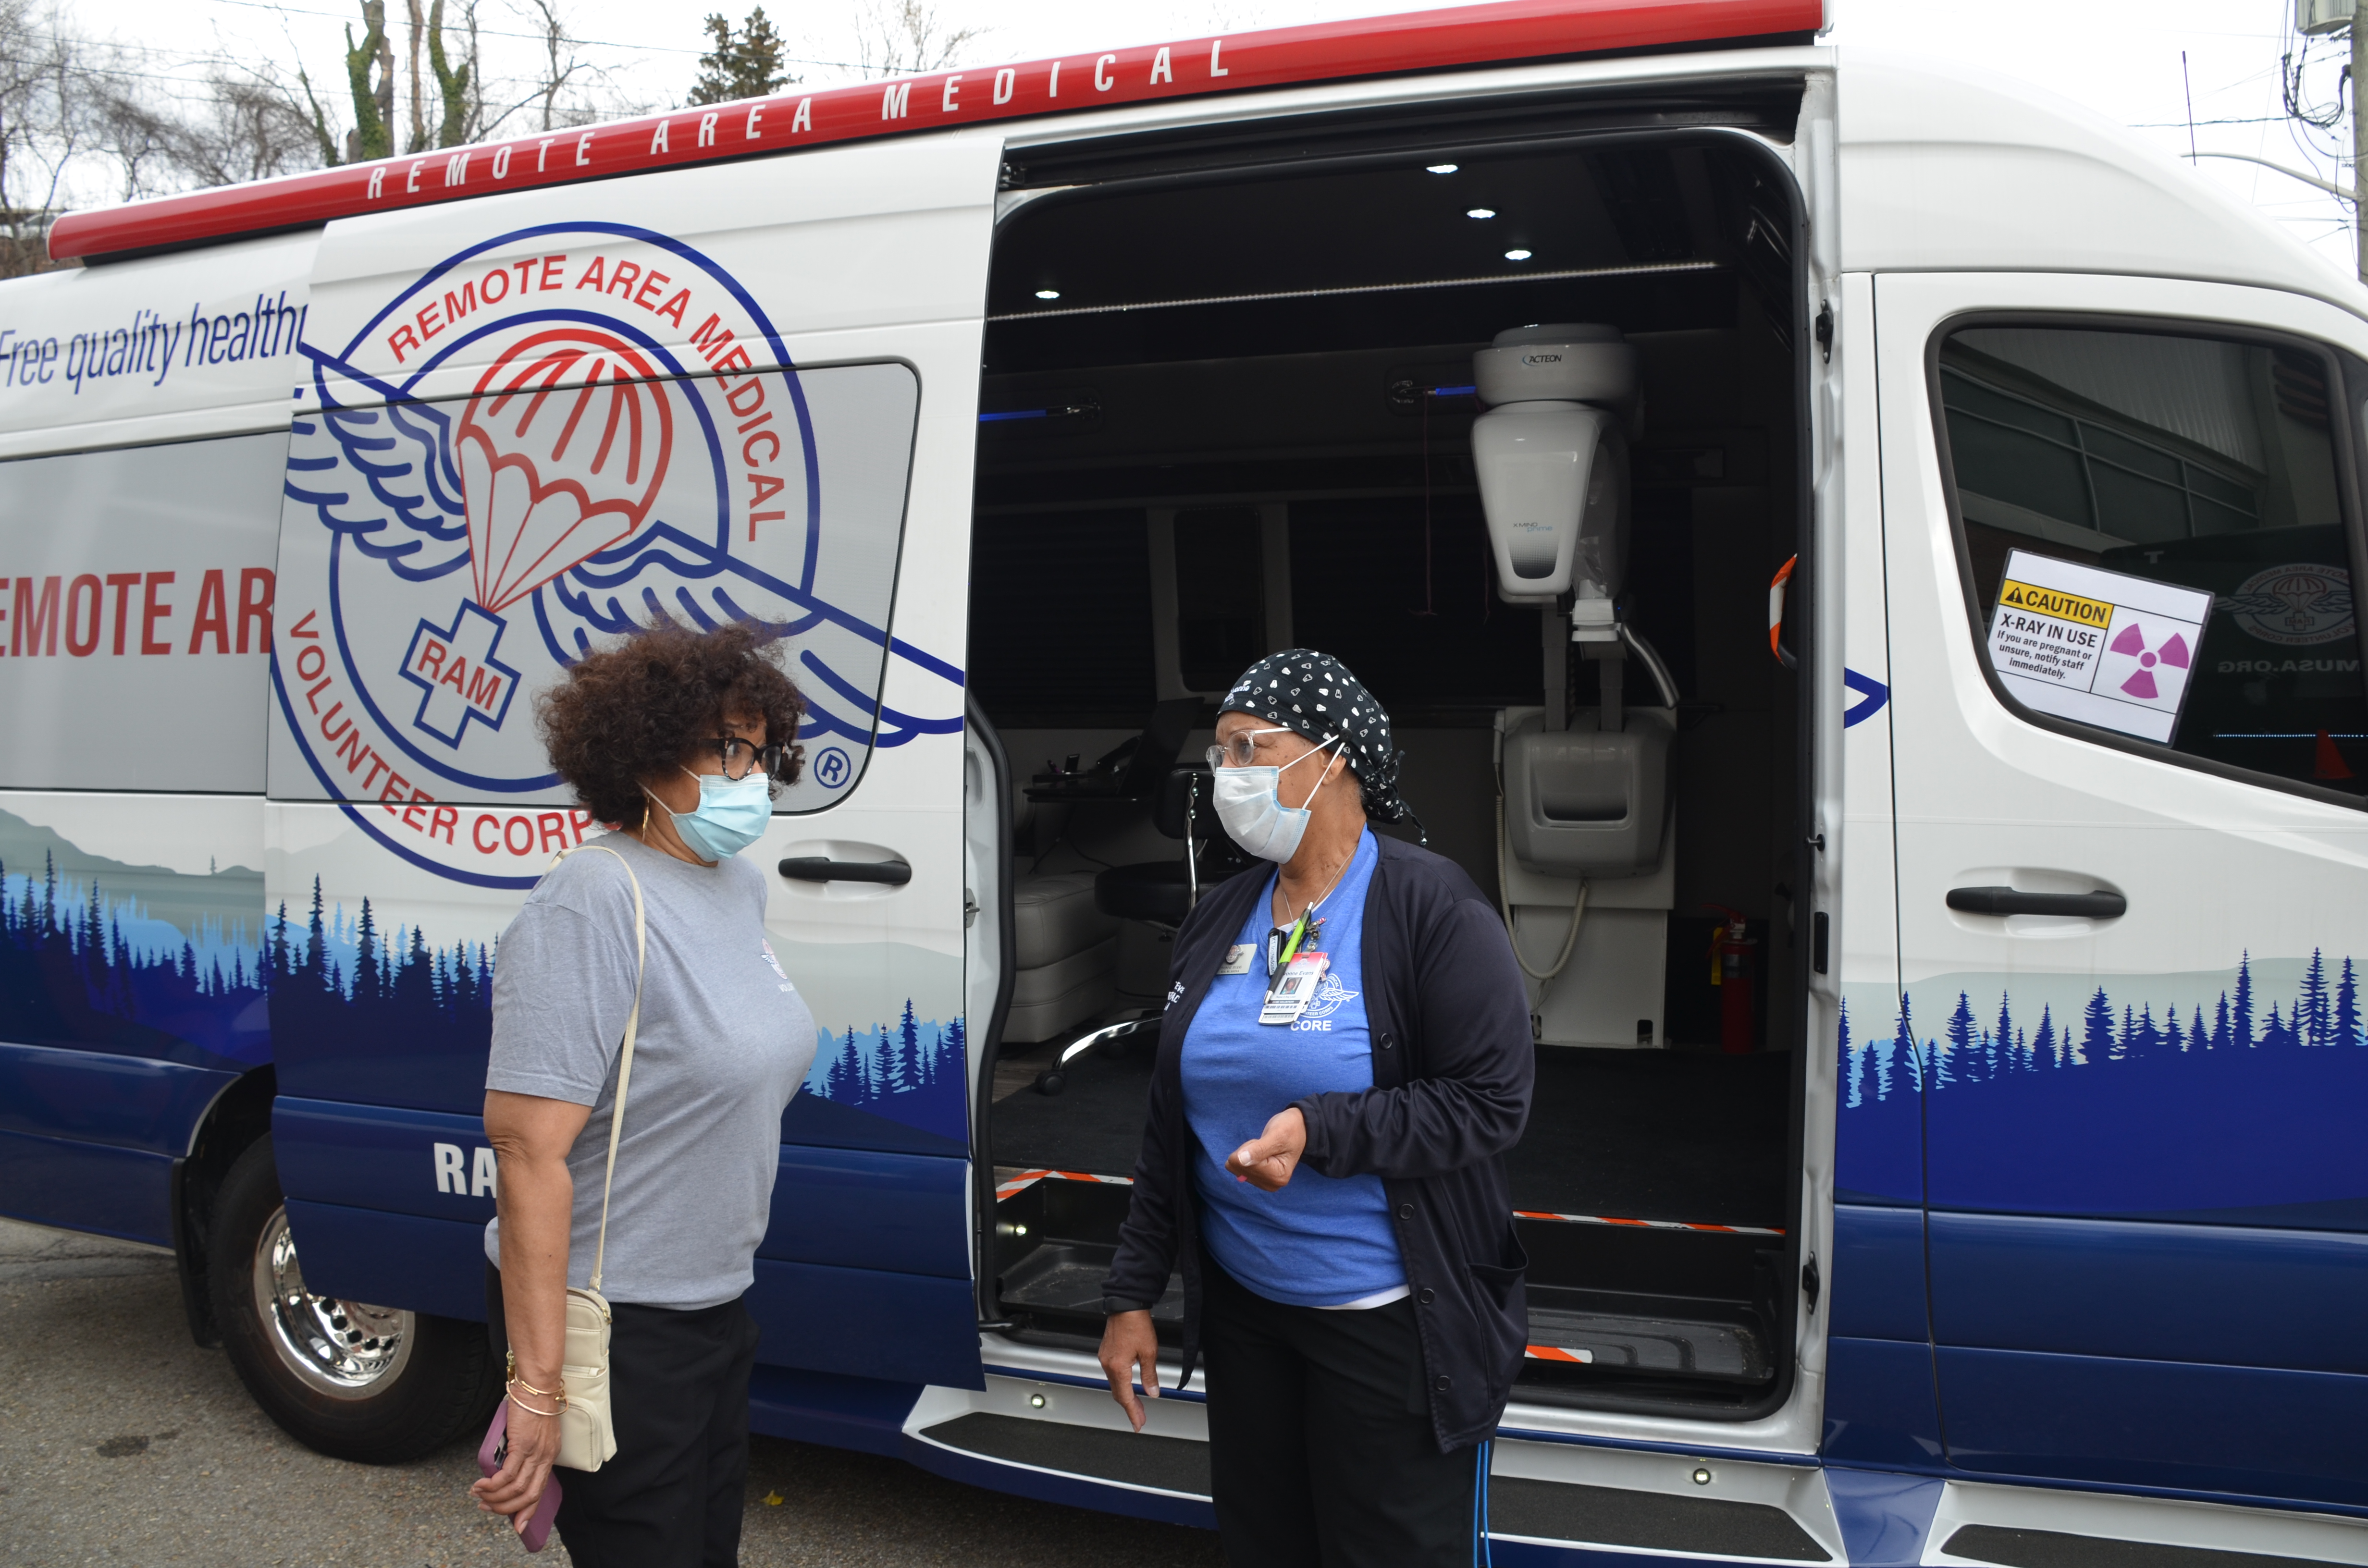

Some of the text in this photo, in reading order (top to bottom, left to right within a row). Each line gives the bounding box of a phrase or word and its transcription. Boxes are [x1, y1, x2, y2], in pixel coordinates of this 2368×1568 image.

[368, 39, 1229, 200] REMOTE AREA MEDICAL
[0, 329, 58, 387] Free
[66, 308, 182, 395] quality
[1529, 354, 1562, 363] ACTEON
[386, 255, 786, 542] REMOTE AREA MEDICAL
[2025, 590, 2107, 623] CAUTION
[1997, 630, 2092, 661] If you are pregnant or
[2000, 612, 2098, 648] X-RAY IN USE
[417, 638, 502, 711] RAM
[1999, 644, 2085, 671] unsure, notify staff
[2009, 657, 2066, 680] immediately.
[290, 609, 459, 845] VOLUNTEER
[1290, 1020, 1332, 1031] CORE
[1319, 1006, 1333, 1016] CORPS
[434, 1142, 497, 1199] RA
